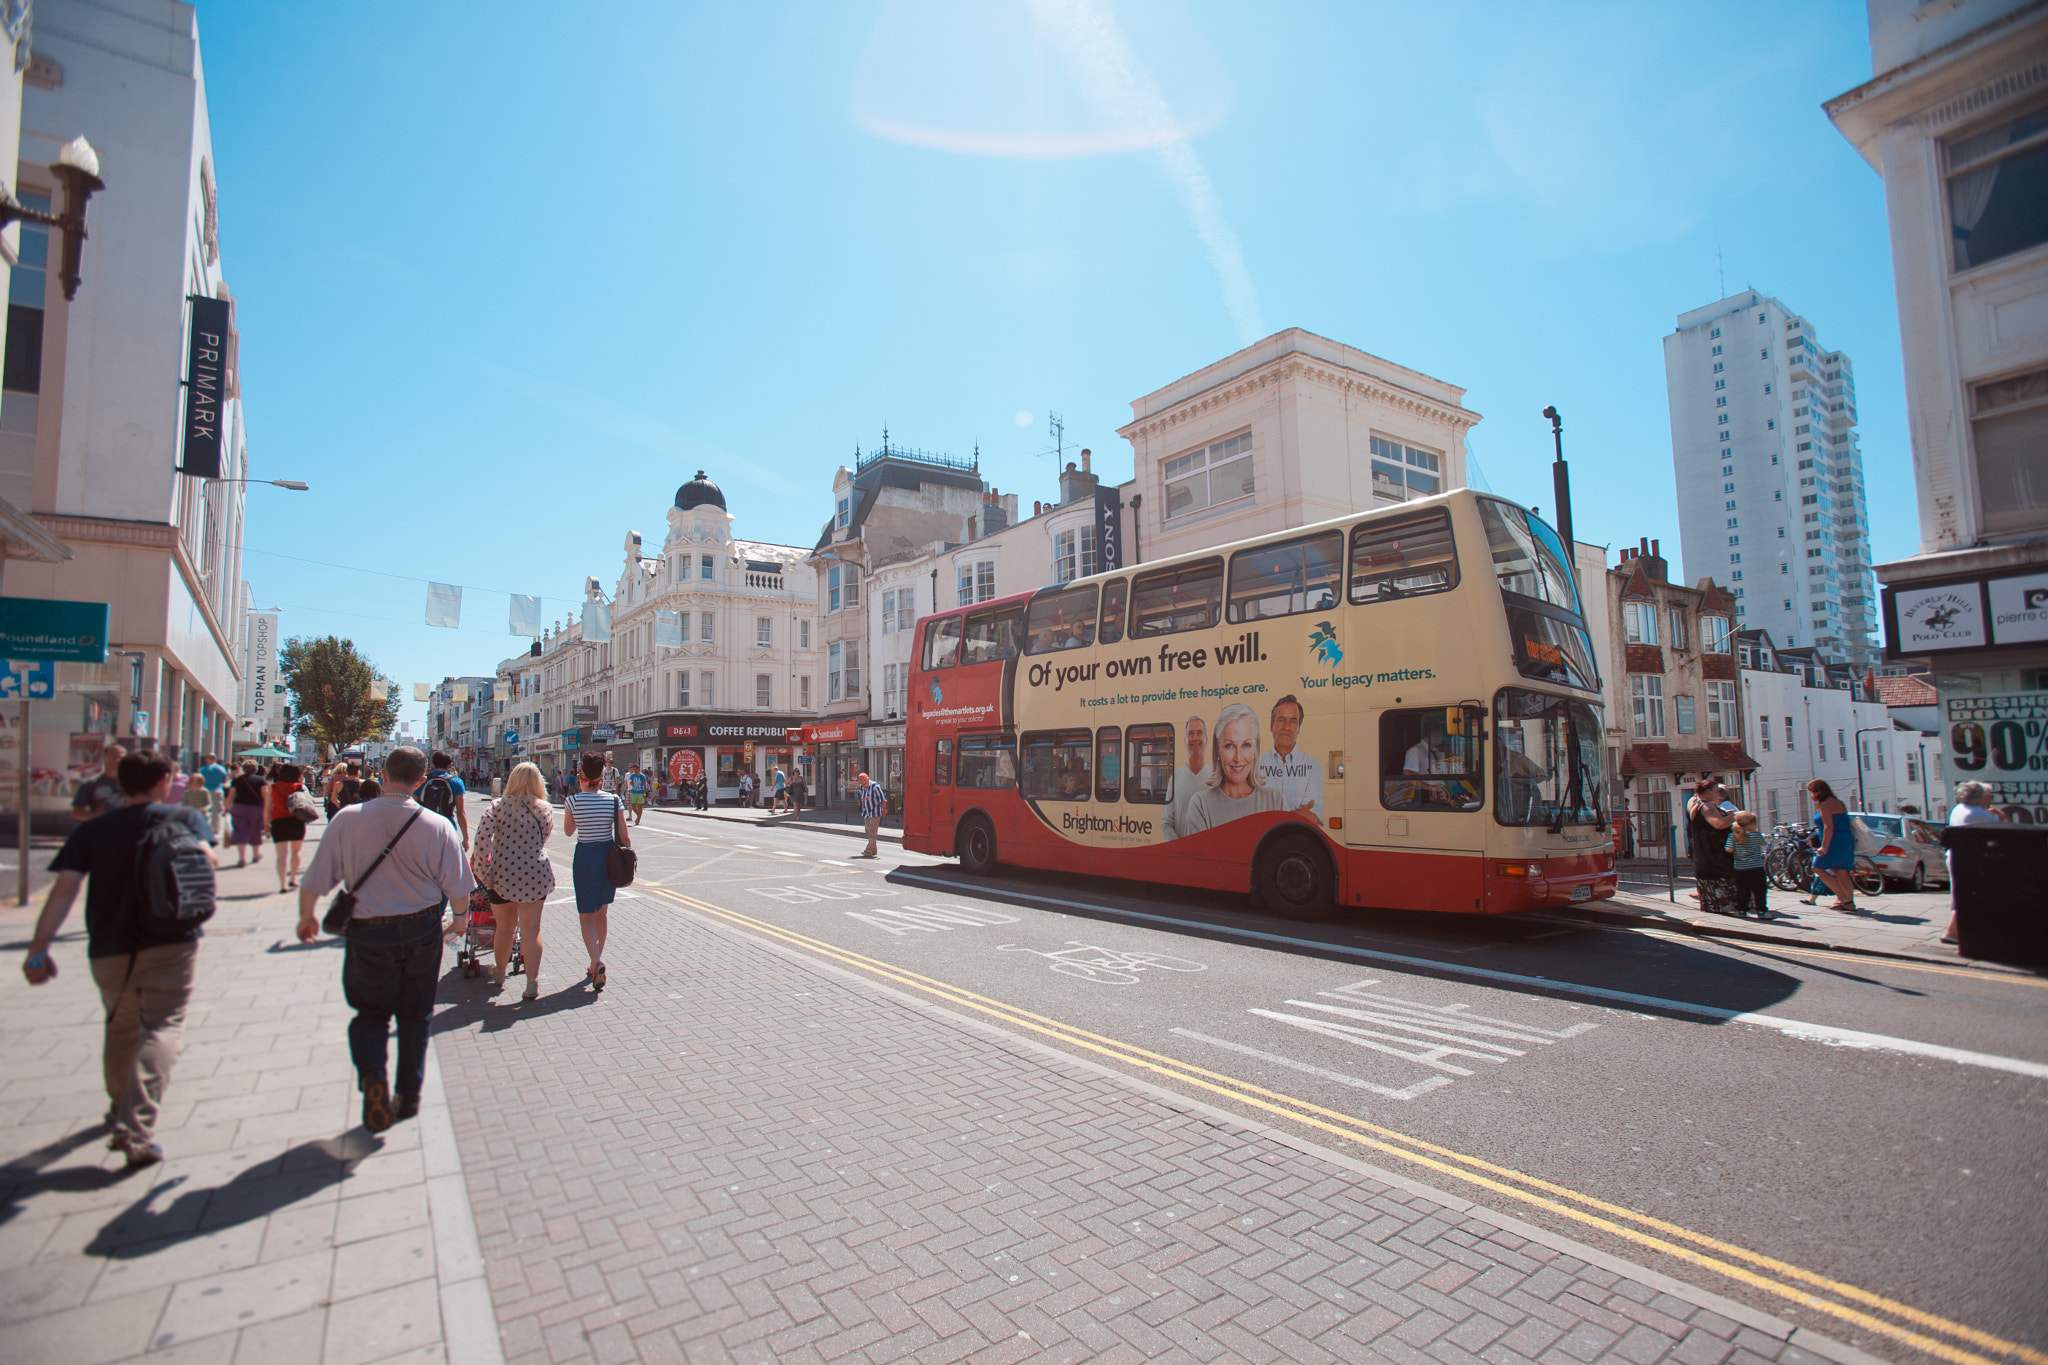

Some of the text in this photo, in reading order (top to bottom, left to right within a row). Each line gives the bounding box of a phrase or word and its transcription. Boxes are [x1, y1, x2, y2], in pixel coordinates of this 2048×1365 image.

[194, 331, 220, 441] PRIMARK
[1103, 503, 1115, 572] SONY
[1904, 594, 1974, 618] BEVERLY HILLS
[1996, 610, 2037, 625] pierre
[1912, 629, 1972, 642] POLO CLUB
[254, 617, 268, 714] TOPMAN TOPSHOP
[1028, 631, 1267, 691] Of your own free will.
[1300, 668, 1436, 690] Your legacy matters.
[1080, 683, 1269, 707] It costs a lot to provide free hospice care.
[1950, 695, 2048, 709] CLOSING
[1950, 707, 2048, 720] DOWN
[673, 727, 691, 735] DELI
[709, 726, 787, 737] COFFEE REPUBLI
[818, 727, 844, 739] Santander
[679, 763, 694, 775] £1
[1063, 806, 1152, 834] Brighton&Hove
[744, 881, 900, 905] BUS
[843, 902, 1021, 936] AND
[1168, 979, 1602, 1101] LANE
